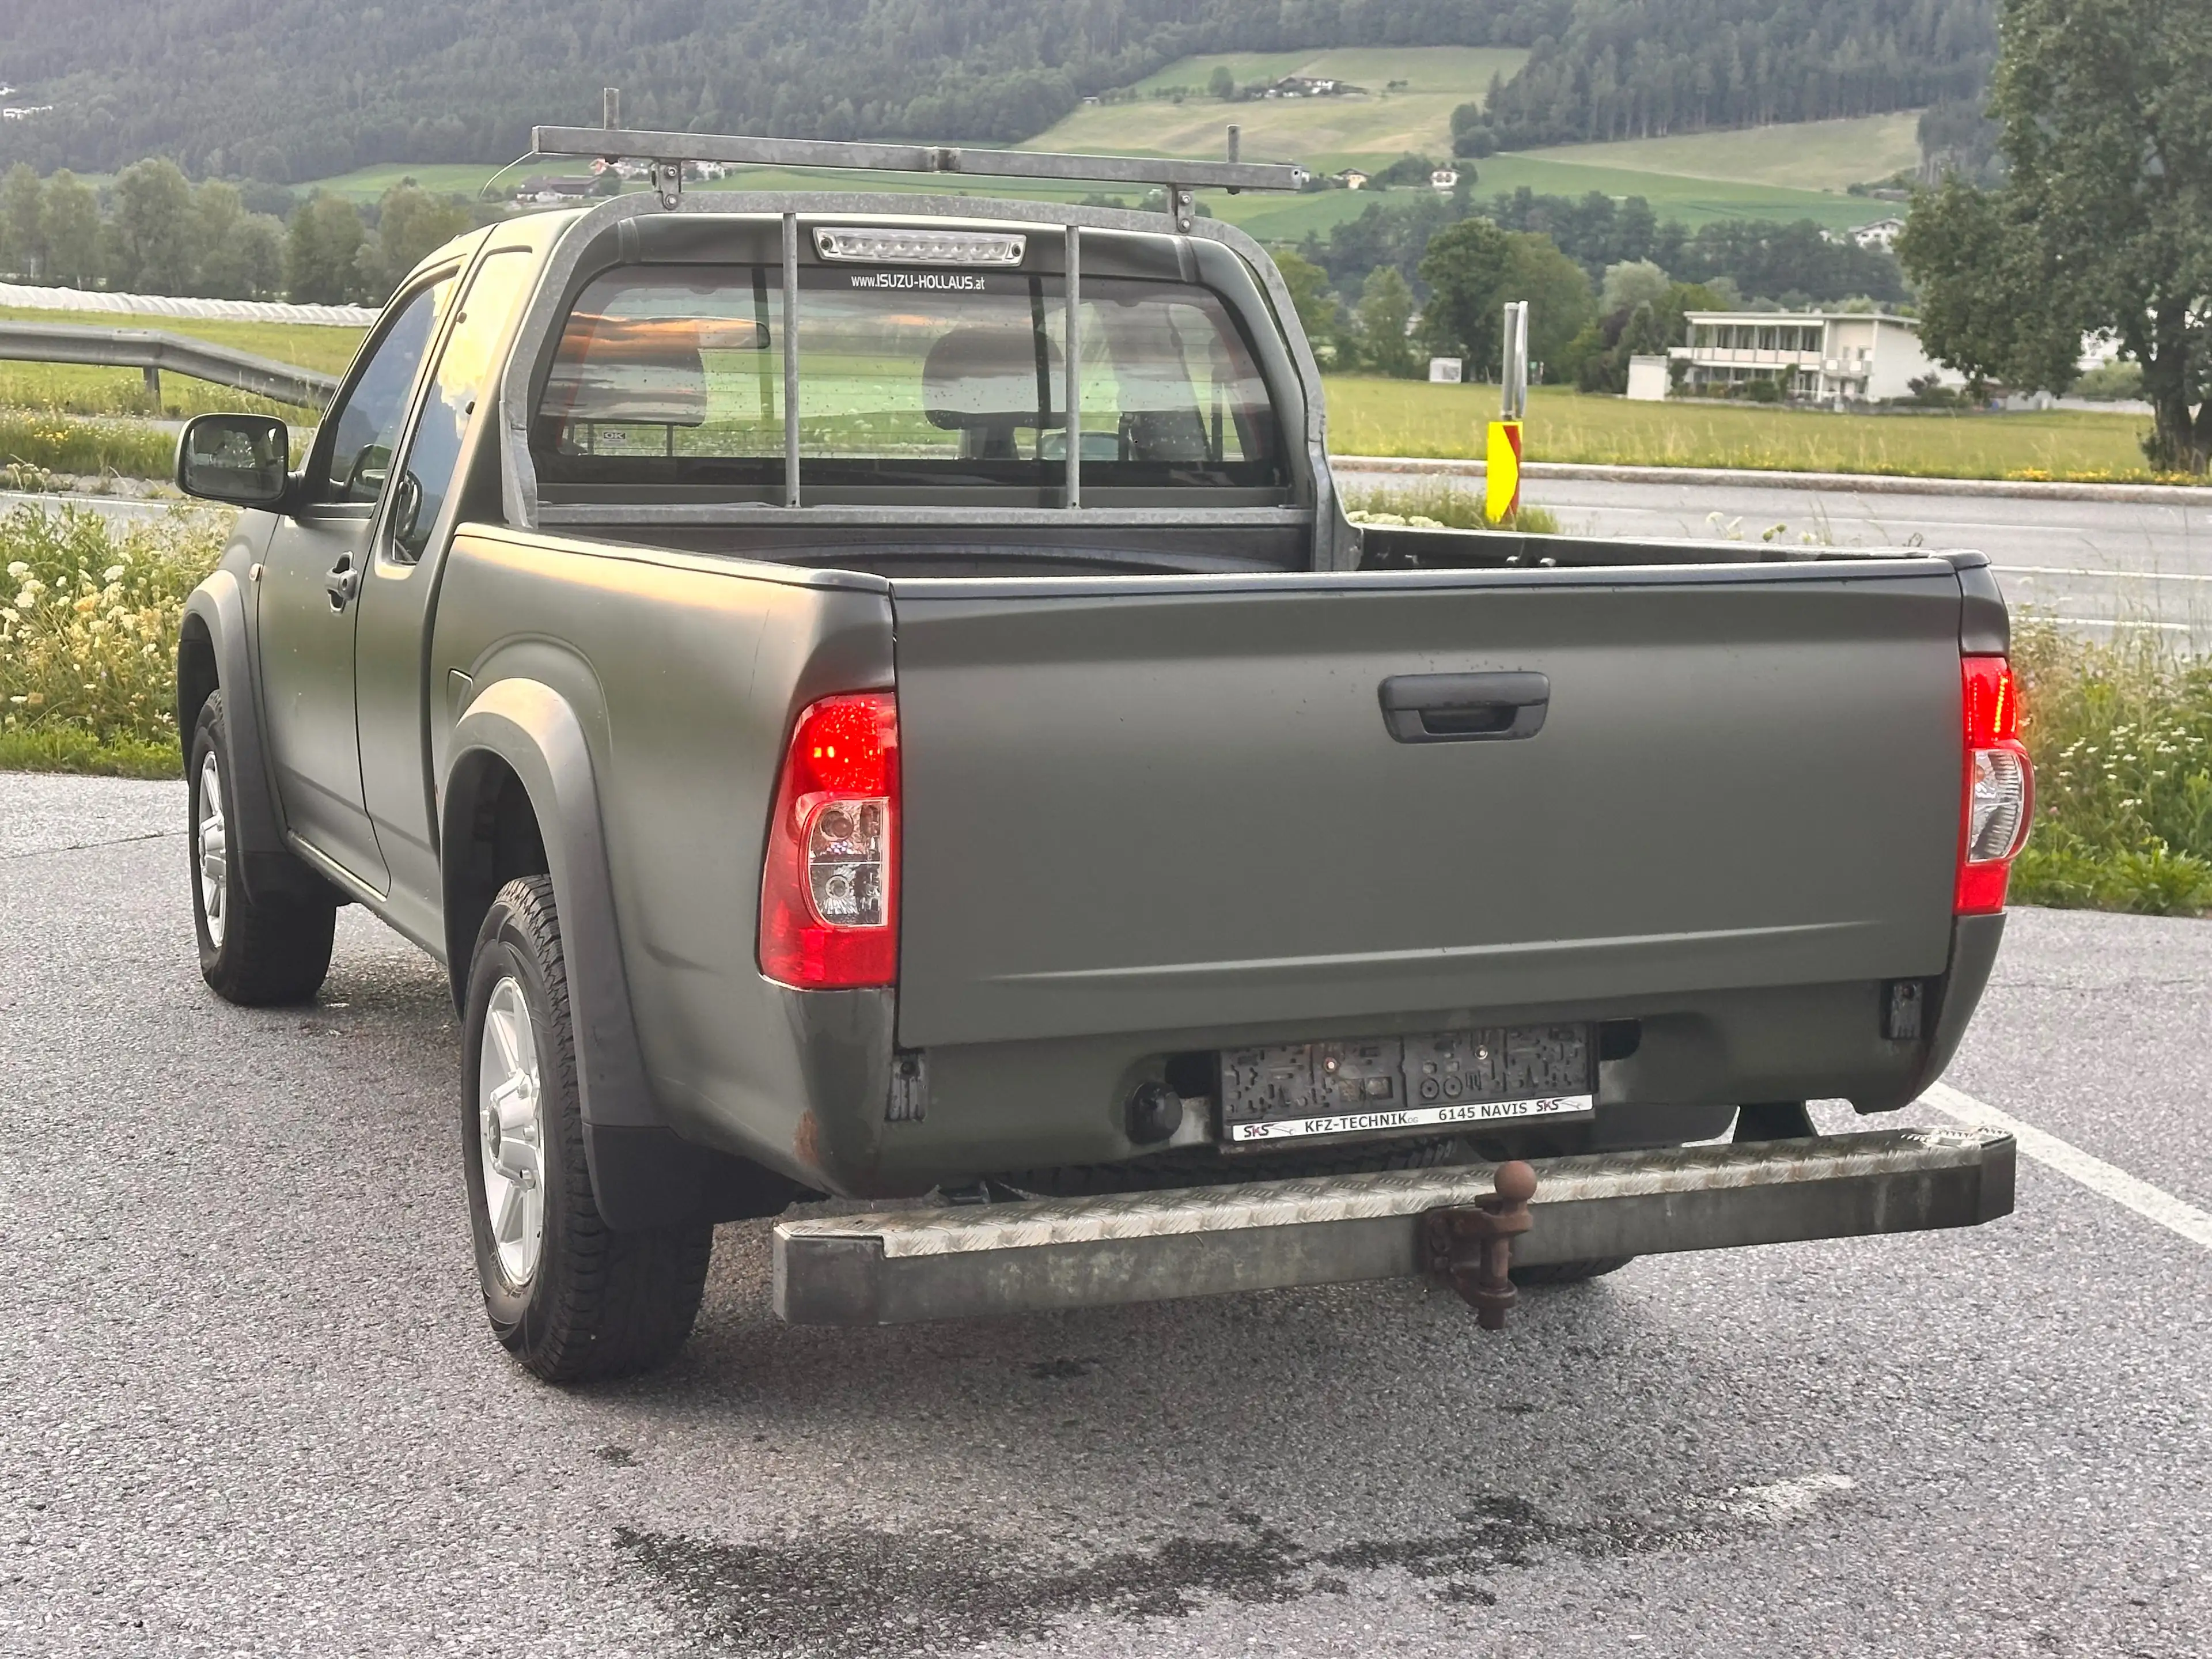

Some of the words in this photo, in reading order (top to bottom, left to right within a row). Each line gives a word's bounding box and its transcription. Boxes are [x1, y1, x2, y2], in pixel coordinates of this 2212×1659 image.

[851, 274, 985, 290] www.ISUZU-HOLLAUS.at
[1305, 1112, 1408, 1133] KFZ-TECHNIK
[1438, 1107, 1475, 1121] 6145
[1481, 1102, 1527, 1118] NAVIS
